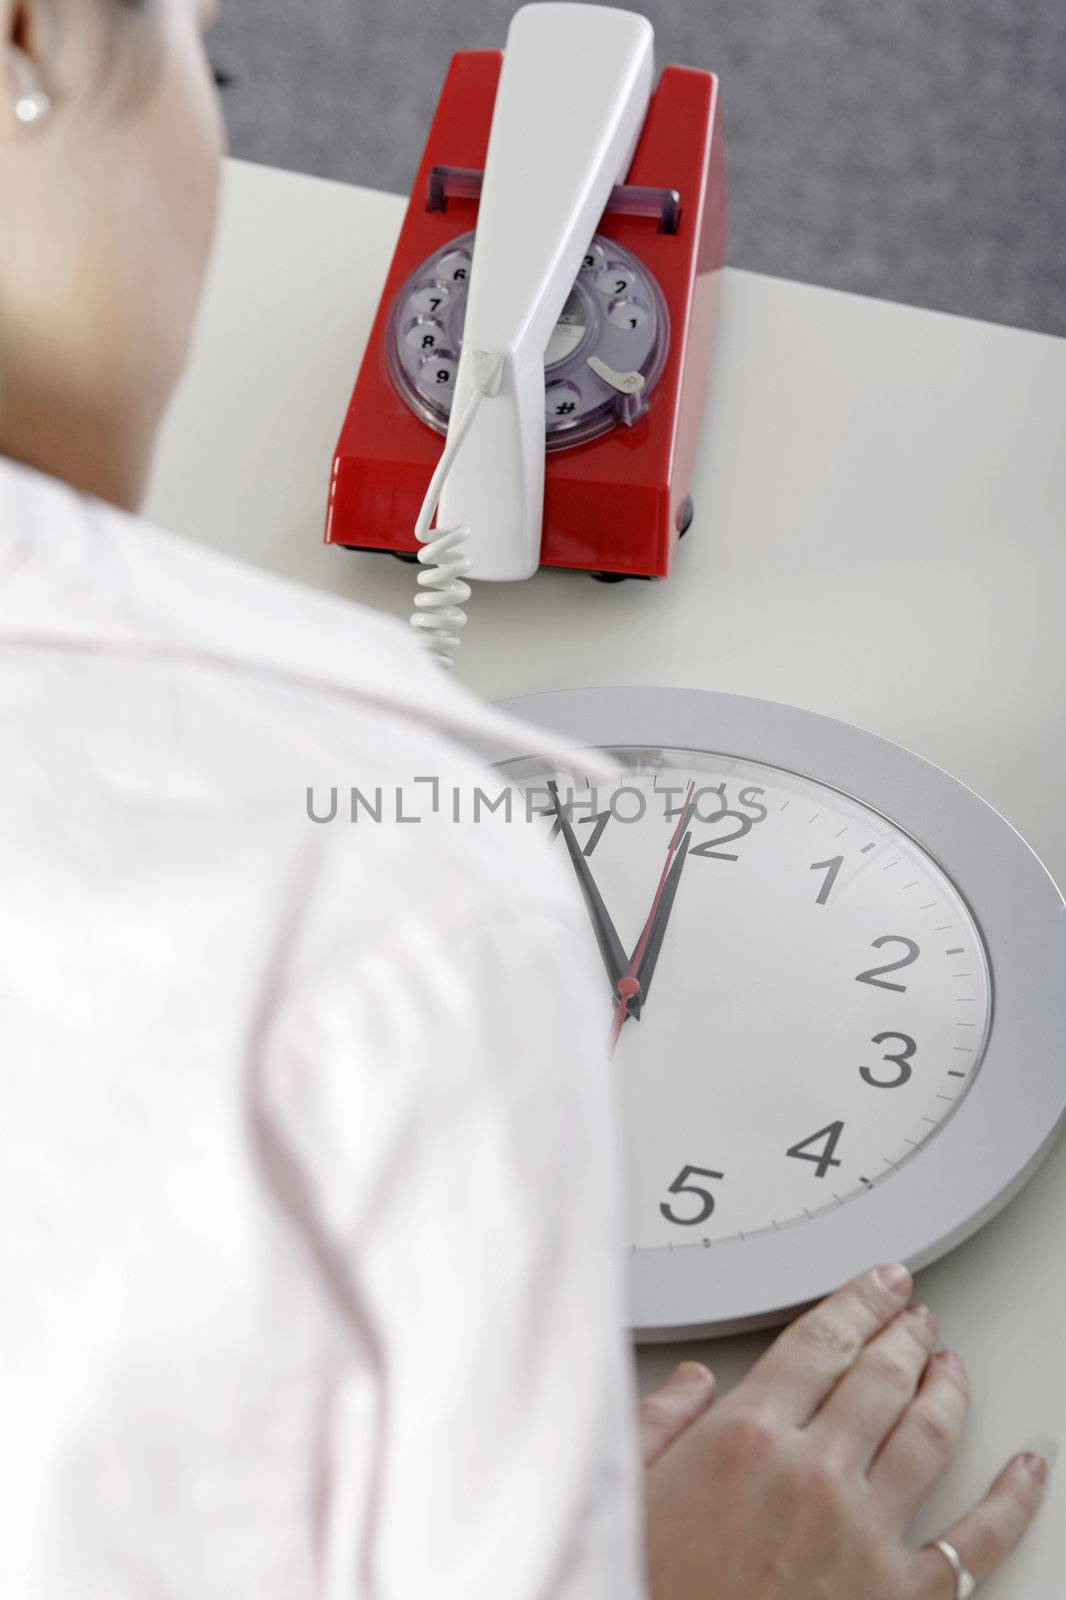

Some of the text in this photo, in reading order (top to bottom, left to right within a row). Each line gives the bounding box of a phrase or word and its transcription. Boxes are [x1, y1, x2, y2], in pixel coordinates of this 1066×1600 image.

[615, 280, 627, 293] 2
[429, 299, 442, 311] 7
[629, 318, 638, 329] 1
[422, 335, 435, 349] 8
[436, 370, 450, 384] 9
[623, 376, 636, 386] R
[663, 802, 752, 862] 12
[809, 855, 845, 905] 1
[854, 935, 920, 993] 2
[859, 1031, 917, 1088] 3
[785, 1120, 845, 1179] 4
[659, 1164, 724, 1226] 5
